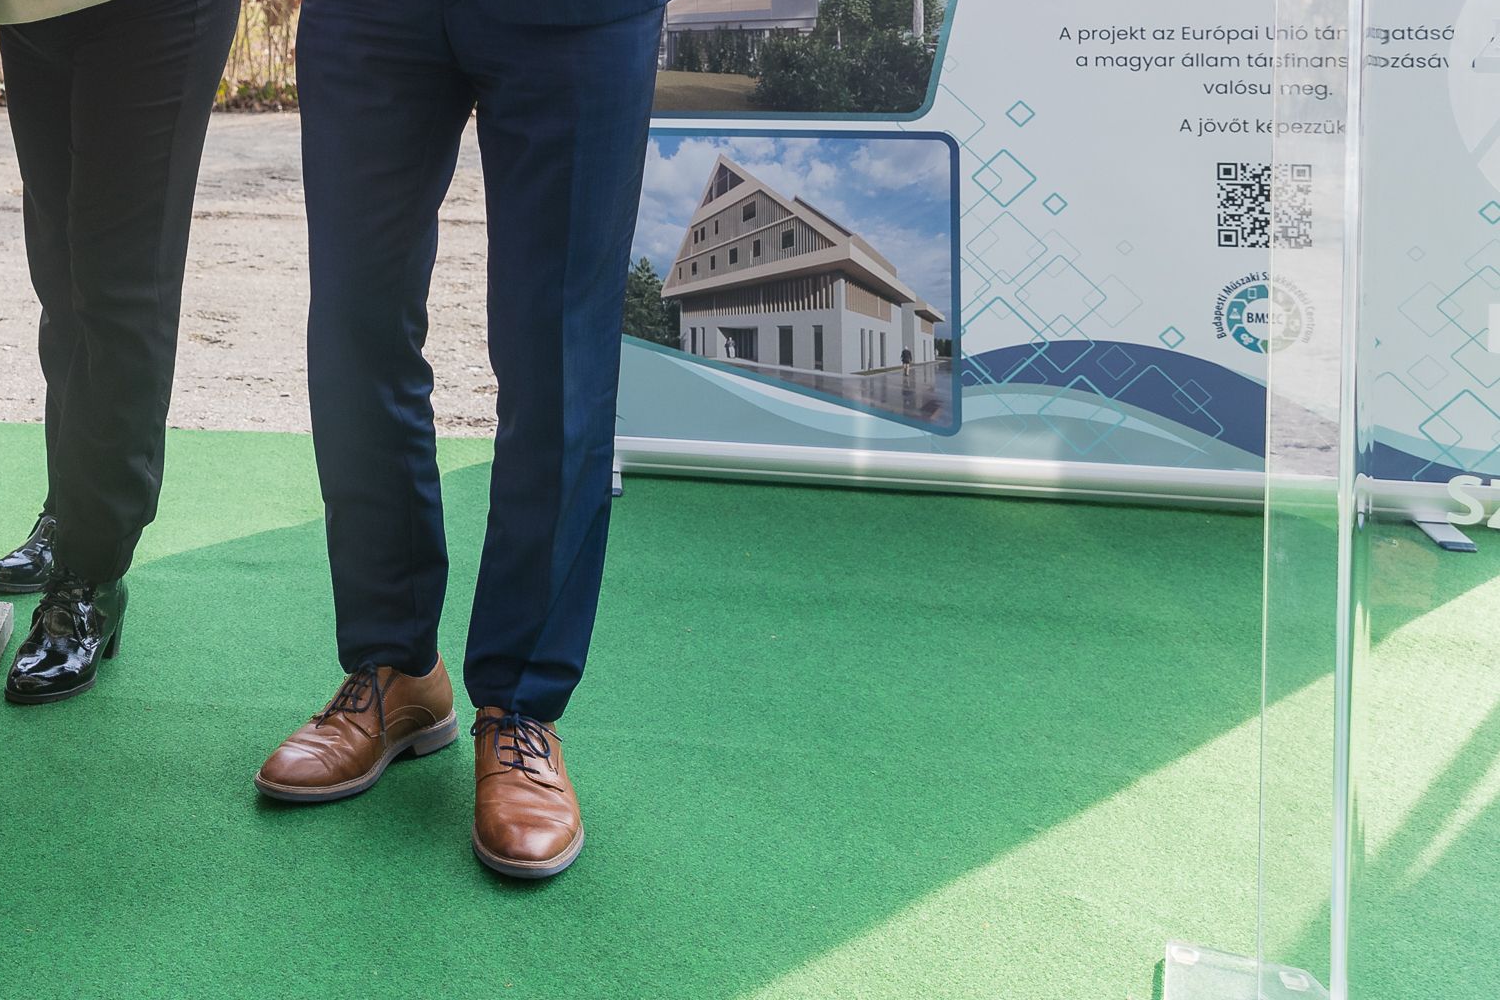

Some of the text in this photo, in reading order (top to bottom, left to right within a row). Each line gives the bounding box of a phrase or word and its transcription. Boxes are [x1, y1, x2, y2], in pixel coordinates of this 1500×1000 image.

[1058, 26, 1072, 40] A
[1077, 25, 1147, 45] projekt
[1151, 28, 1175, 40] az
[1180, 26, 1259, 45] Európai
[1074, 55, 1088, 66] a
[1094, 55, 1176, 71] magyar
[1180, 52, 1241, 67] állam
[1203, 79, 1333, 100] valósu meg.
[1178, 118, 1193, 132] A
[1198, 117, 1250, 137] jövőt
[1212, 293, 1227, 339] Budapesti
